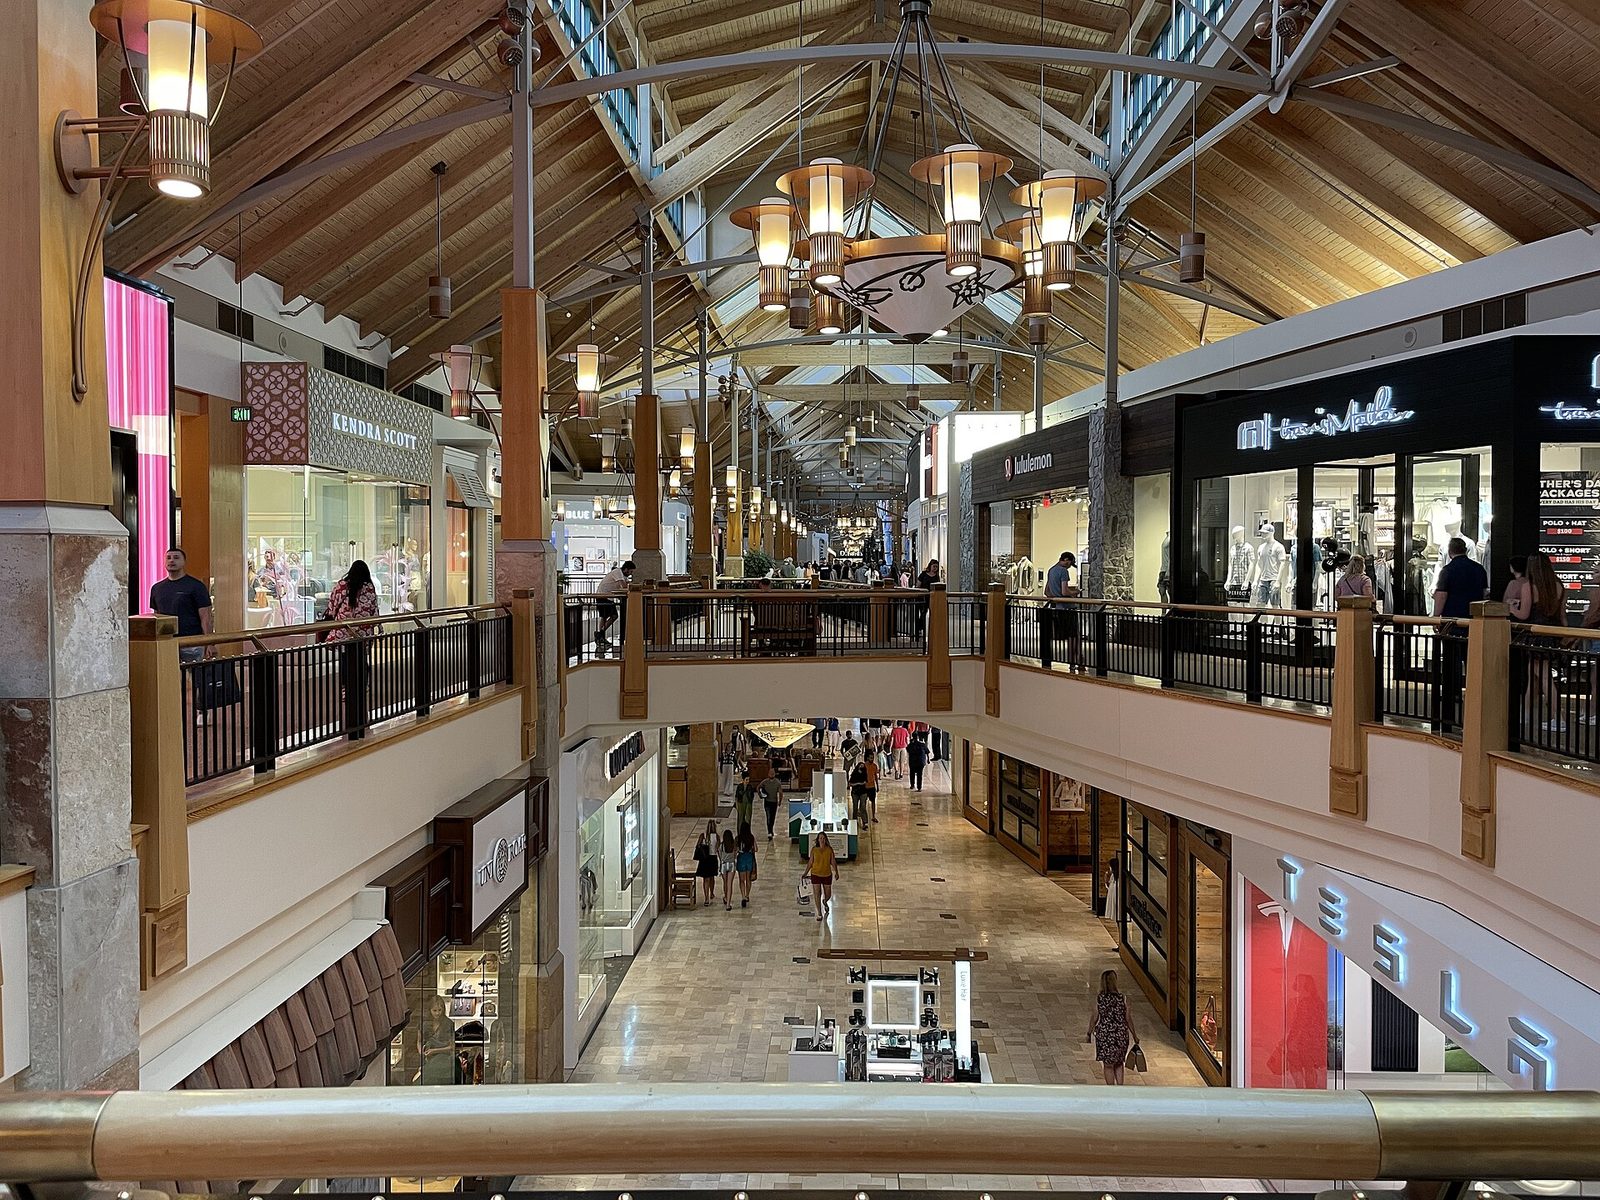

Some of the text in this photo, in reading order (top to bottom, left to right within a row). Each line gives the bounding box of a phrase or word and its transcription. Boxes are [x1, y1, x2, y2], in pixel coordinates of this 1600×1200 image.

[234, 409, 250, 420] EXIT
[332, 412, 417, 450] KENDRA SCOTT
[1014, 452, 1053, 475] lululemon
[1540, 489, 1600, 498] ACKAGES
[565, 510, 590, 520] BLUE
[1276, 856, 1557, 1091] TESLA
